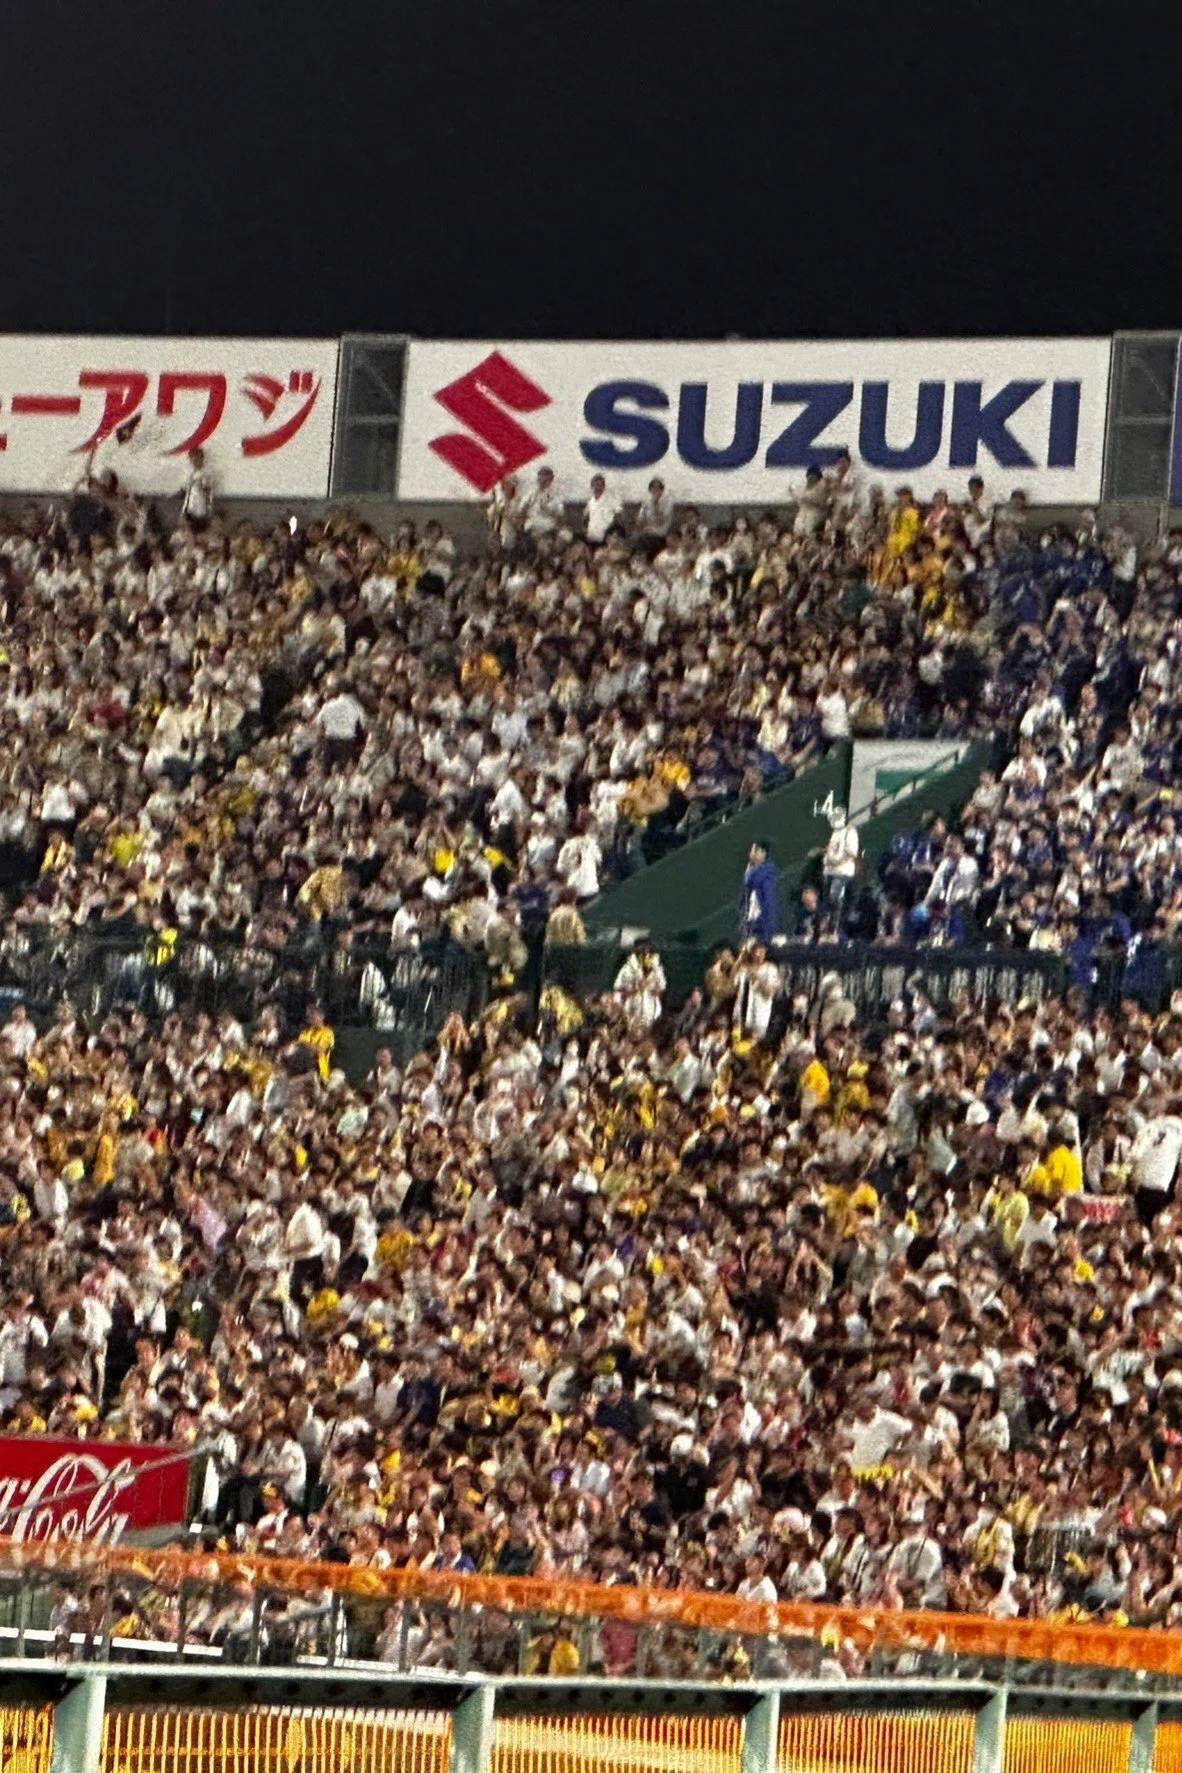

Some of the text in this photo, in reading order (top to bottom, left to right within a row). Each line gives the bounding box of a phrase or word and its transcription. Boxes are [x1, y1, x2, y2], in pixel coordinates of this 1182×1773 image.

[0, 369, 321, 457] ーアワジ
[580, 380, 1081, 471] SUZUKI
